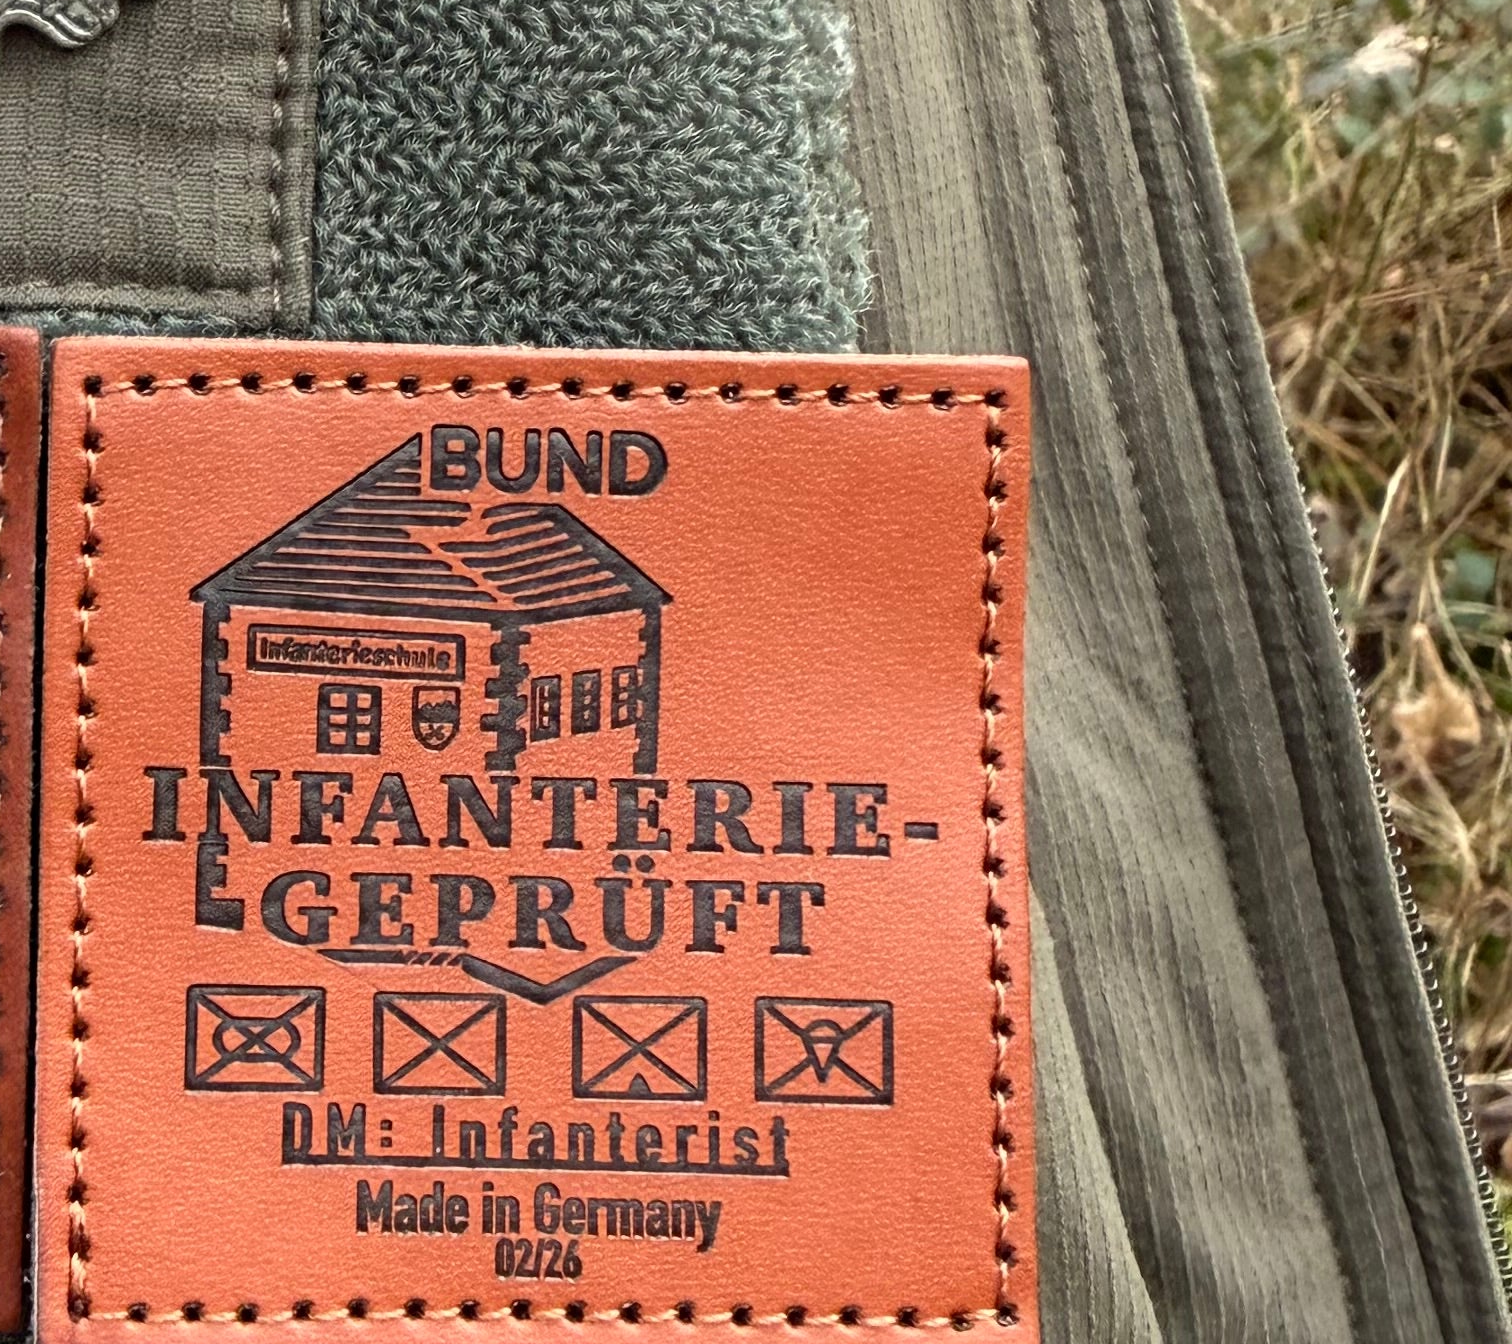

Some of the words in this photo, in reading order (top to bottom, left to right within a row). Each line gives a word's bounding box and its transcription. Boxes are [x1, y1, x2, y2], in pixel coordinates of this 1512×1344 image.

[430, 424, 668, 497] BUND
[260, 636, 451, 671] Infanterieschule
[142, 766, 939, 856] INFANTERIE-
[259, 854, 825, 956] GEPRÜFT
[282, 1102, 393, 1160] DM:
[433, 1105, 790, 1172] Infanterist
[356, 1180, 469, 1234] Made
[481, 1181, 520, 1235] in
[533, 1182, 722, 1252] Germany
[495, 1238, 583, 1279] 02/26
